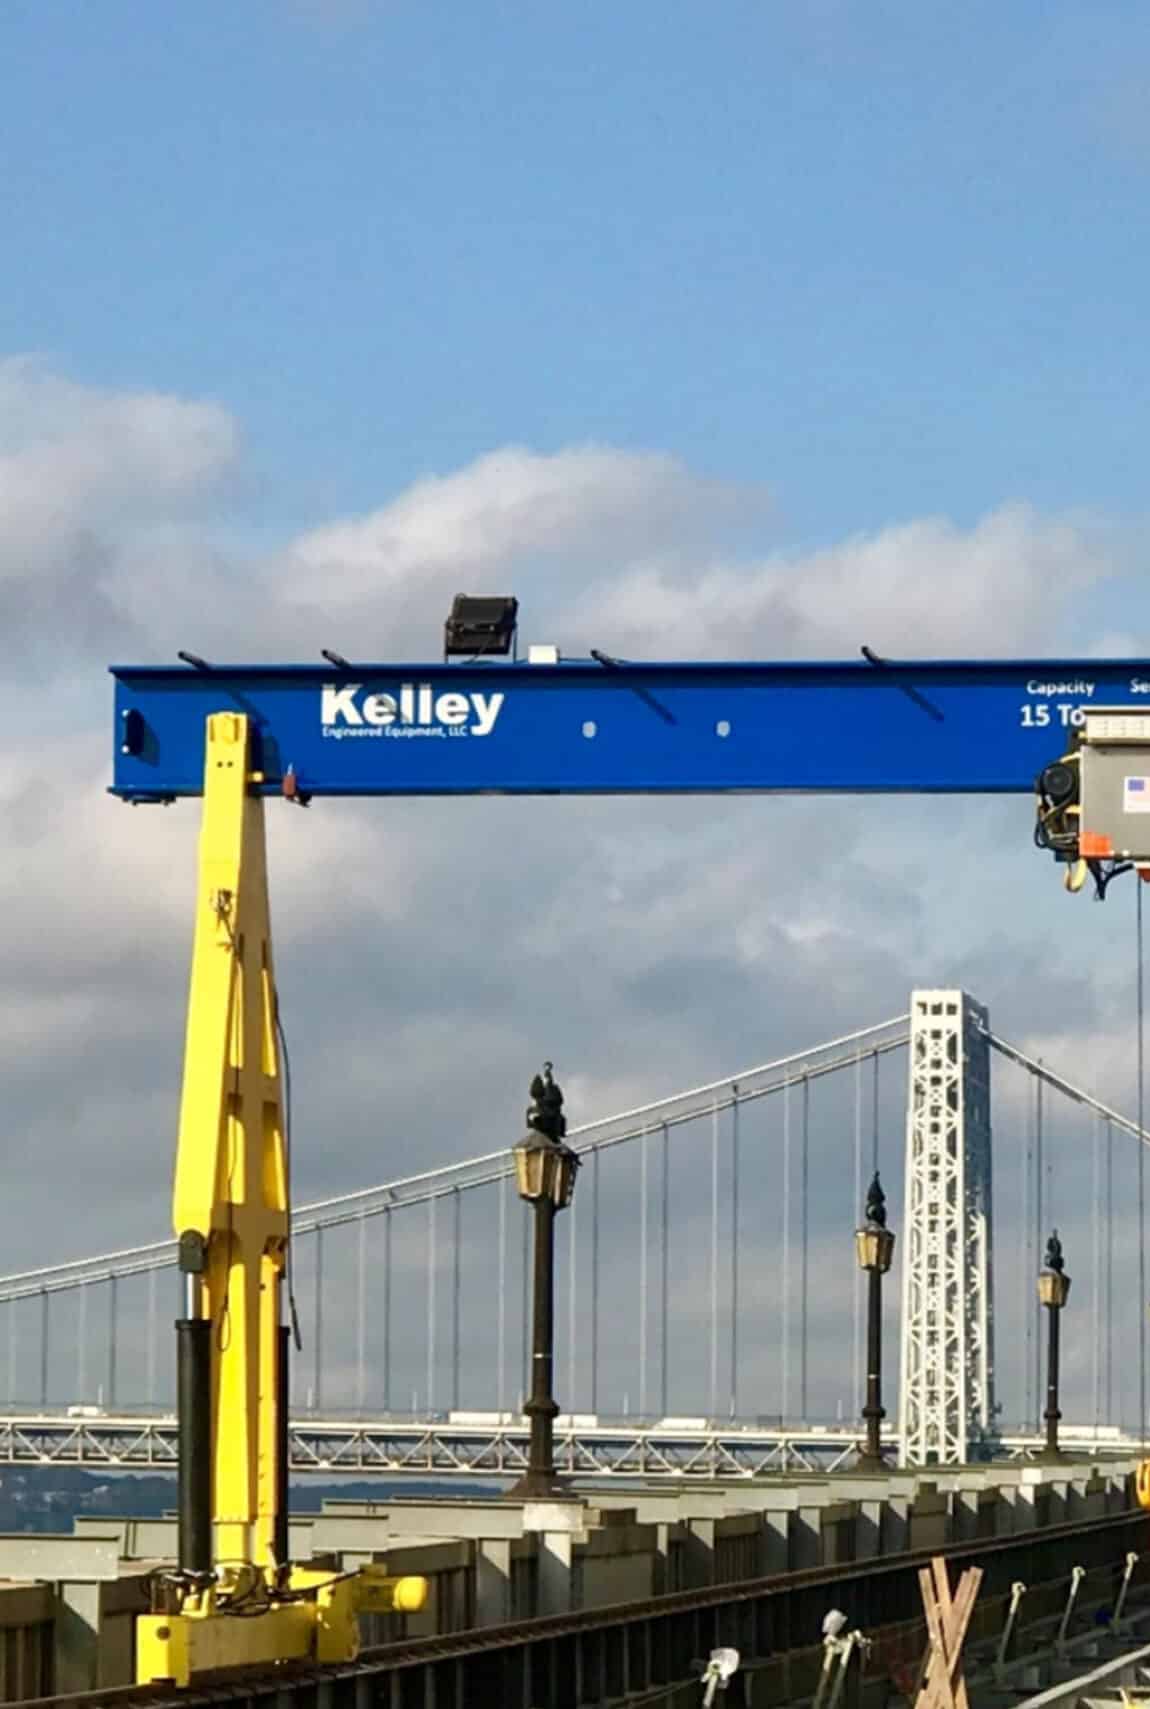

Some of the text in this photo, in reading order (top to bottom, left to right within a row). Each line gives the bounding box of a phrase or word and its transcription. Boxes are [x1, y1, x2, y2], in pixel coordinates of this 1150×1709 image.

[1026, 680, 1095, 697] Capacity
[320, 684, 504, 736] Kelley
[1020, 704, 1086, 727] 15 To
[322, 726, 467, 739] Engineered Equipment, LLC
